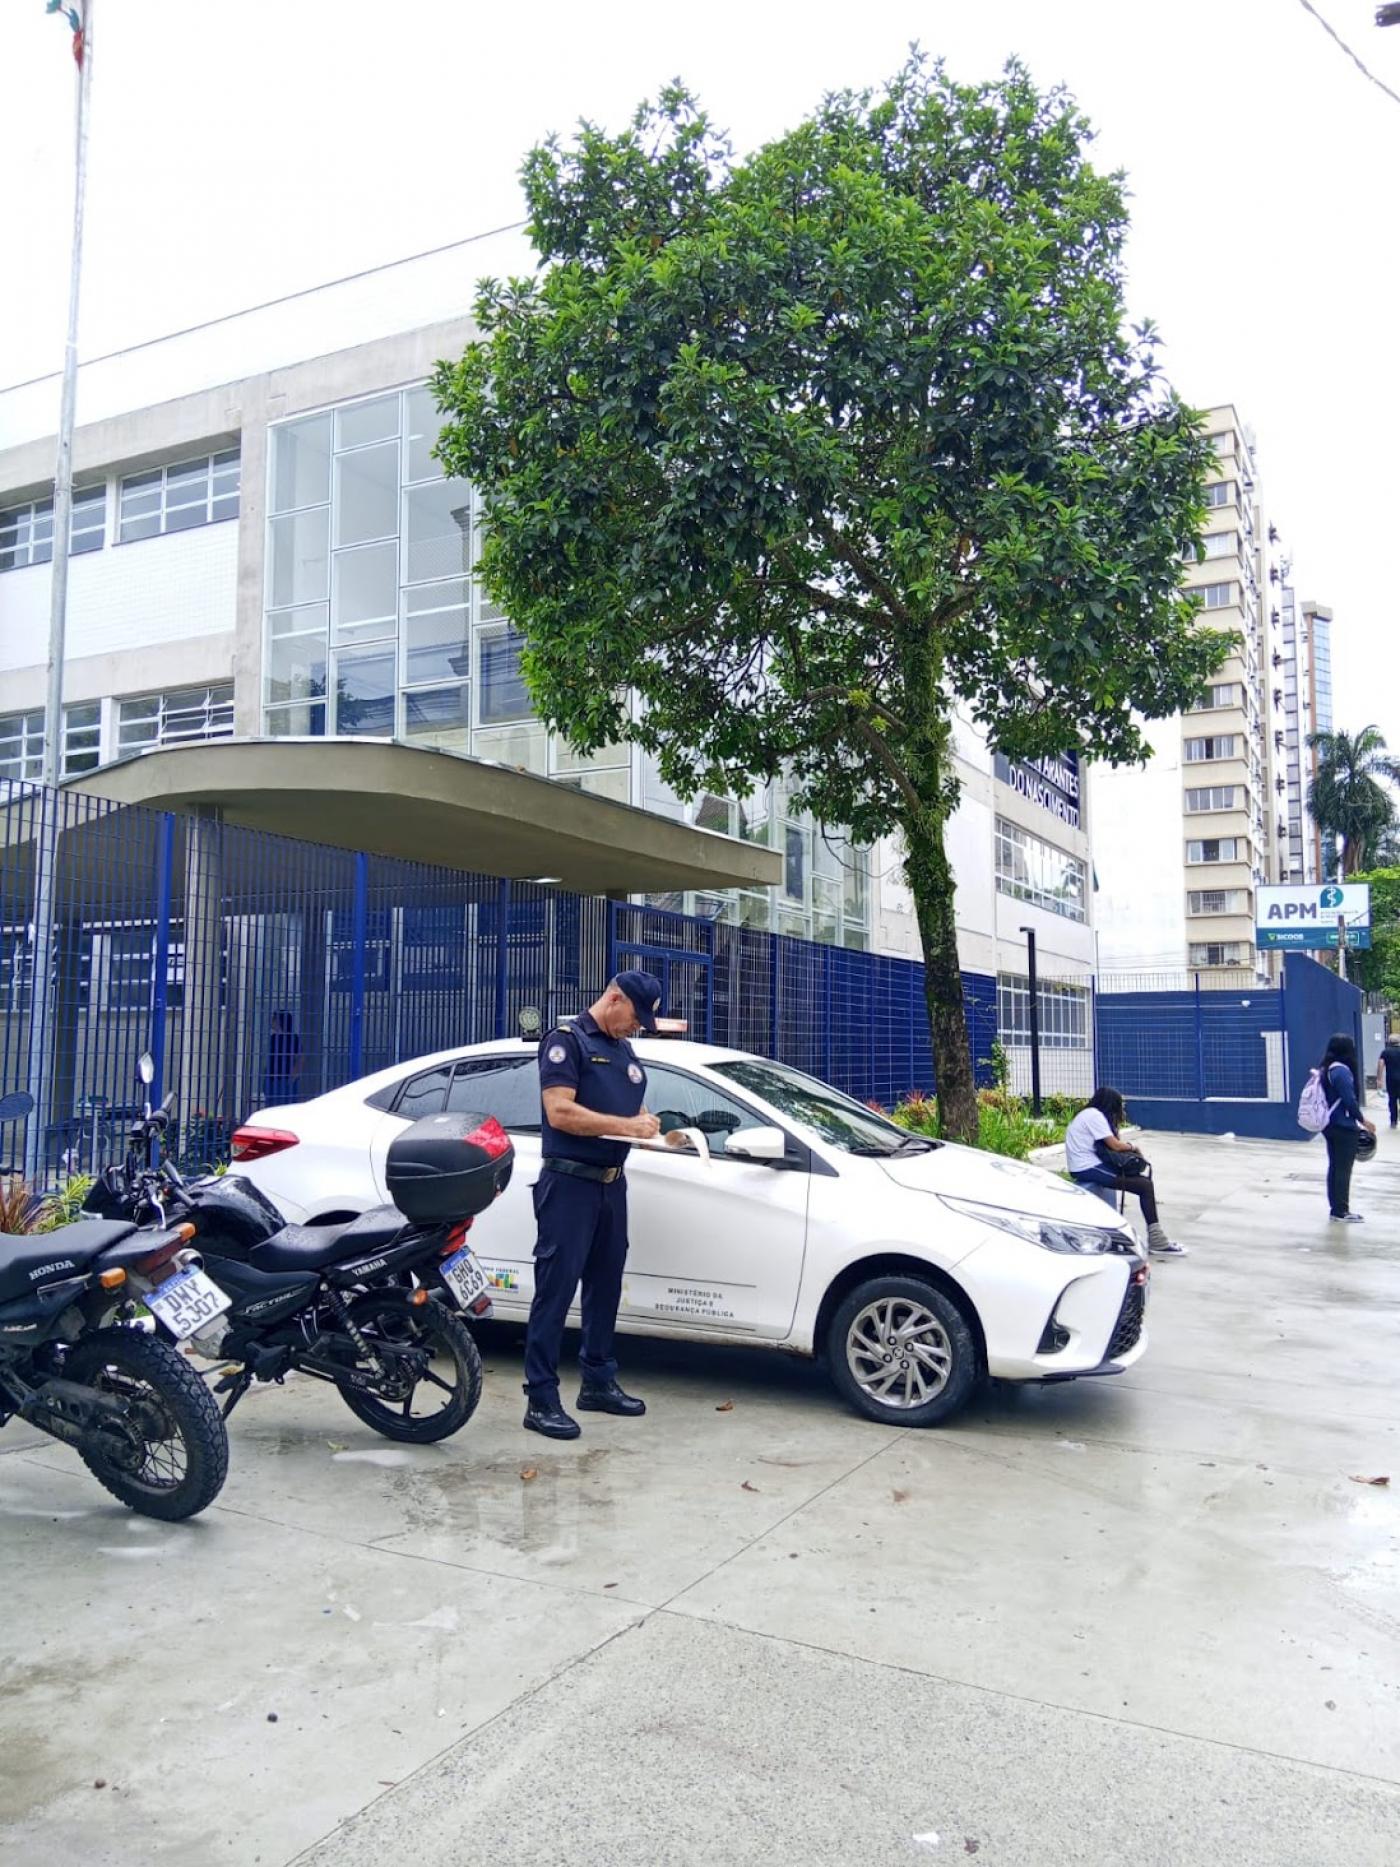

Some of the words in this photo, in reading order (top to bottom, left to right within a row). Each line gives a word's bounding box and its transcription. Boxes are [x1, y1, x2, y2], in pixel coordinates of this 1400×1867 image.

[1268, 903, 1317, 919] APM
[28, 1260, 75, 1281] HONDA
[352, 1258, 388, 1277] YAMAHA
[173, 1290, 219, 1331] 5307
